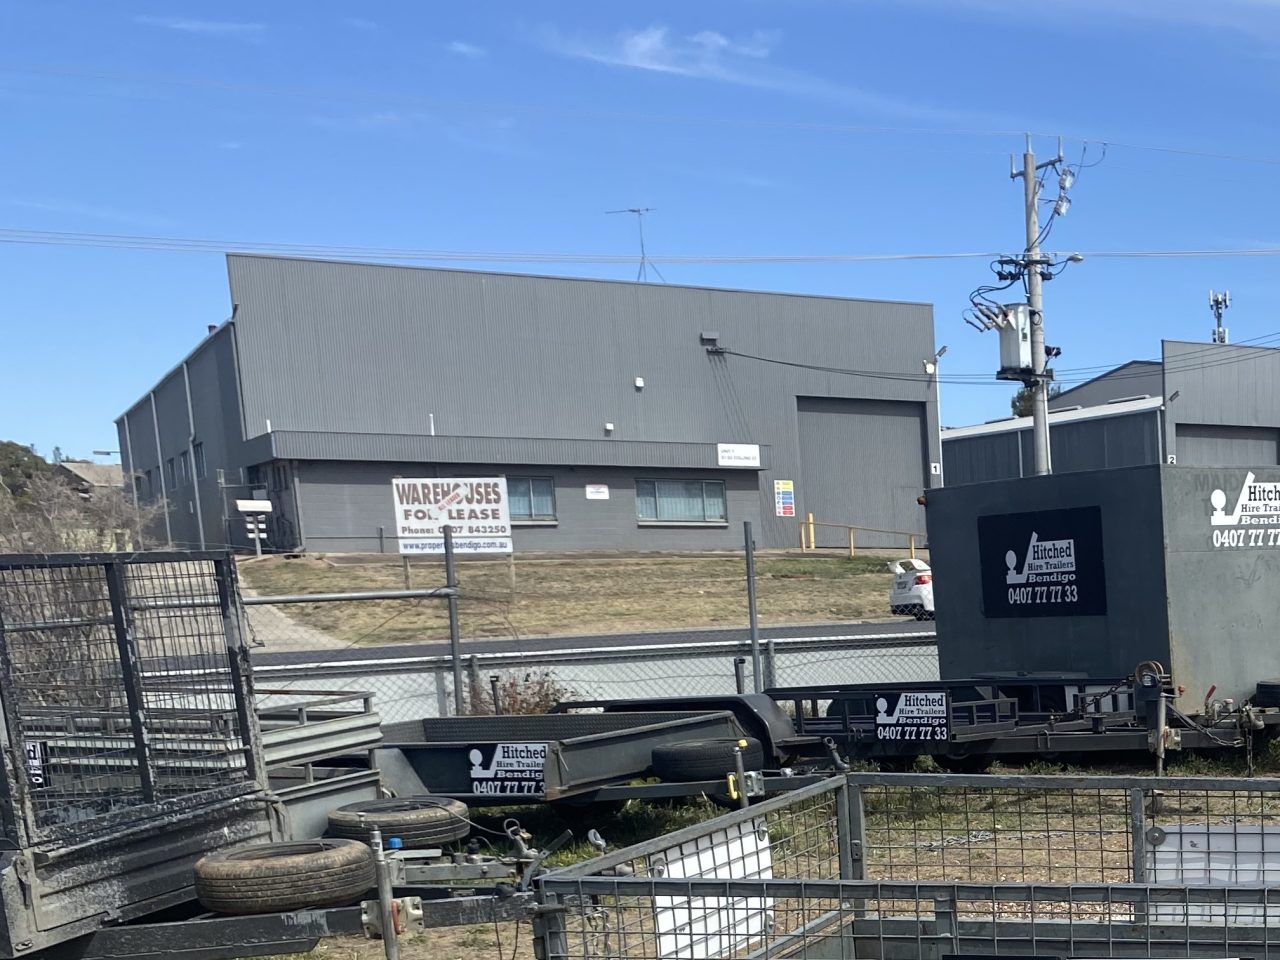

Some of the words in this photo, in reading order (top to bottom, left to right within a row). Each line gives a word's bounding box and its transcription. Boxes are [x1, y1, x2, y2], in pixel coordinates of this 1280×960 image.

[1170, 456, 1174, 464] 2
[933, 465, 937, 473] 1
[395, 482, 502, 505] WAREHOUSES
[448, 508, 500, 520] LEASE
[1241, 504, 1260, 512] Hire
[402, 526, 434, 534] Phone:
[438, 526, 463, 534] 007
[468, 525, 507, 534] 843250
[1212, 529, 1245, 547] 0407
[1248, 529, 1264, 546] 77
[1032, 541, 1072, 560] Hitched
[1028, 562, 1043, 571] Hire
[1045, 561, 1074, 570] Trailers
[1028, 573, 1076, 583] Bendigo
[1008, 587, 1032, 604] 0407
[1035, 586, 1047, 603] 77
[1050, 586, 1062, 602] 77
[1064, 585, 1078, 602] 33
[904, 694, 944, 706] Hitched
[898, 717, 946, 725] Bendigo
[877, 726, 902, 739] 0407
[904, 726, 917, 739] 77
[919, 726, 932, 739] 77
[934, 726, 947, 740] 33
[501, 745, 546, 759] Hitched
[496, 770, 544, 780] Bendig
[473, 781, 501, 794] 0407
[504, 781, 519, 794] 77
[521, 781, 536, 794] 77
[539, 781, 545, 794] 3
